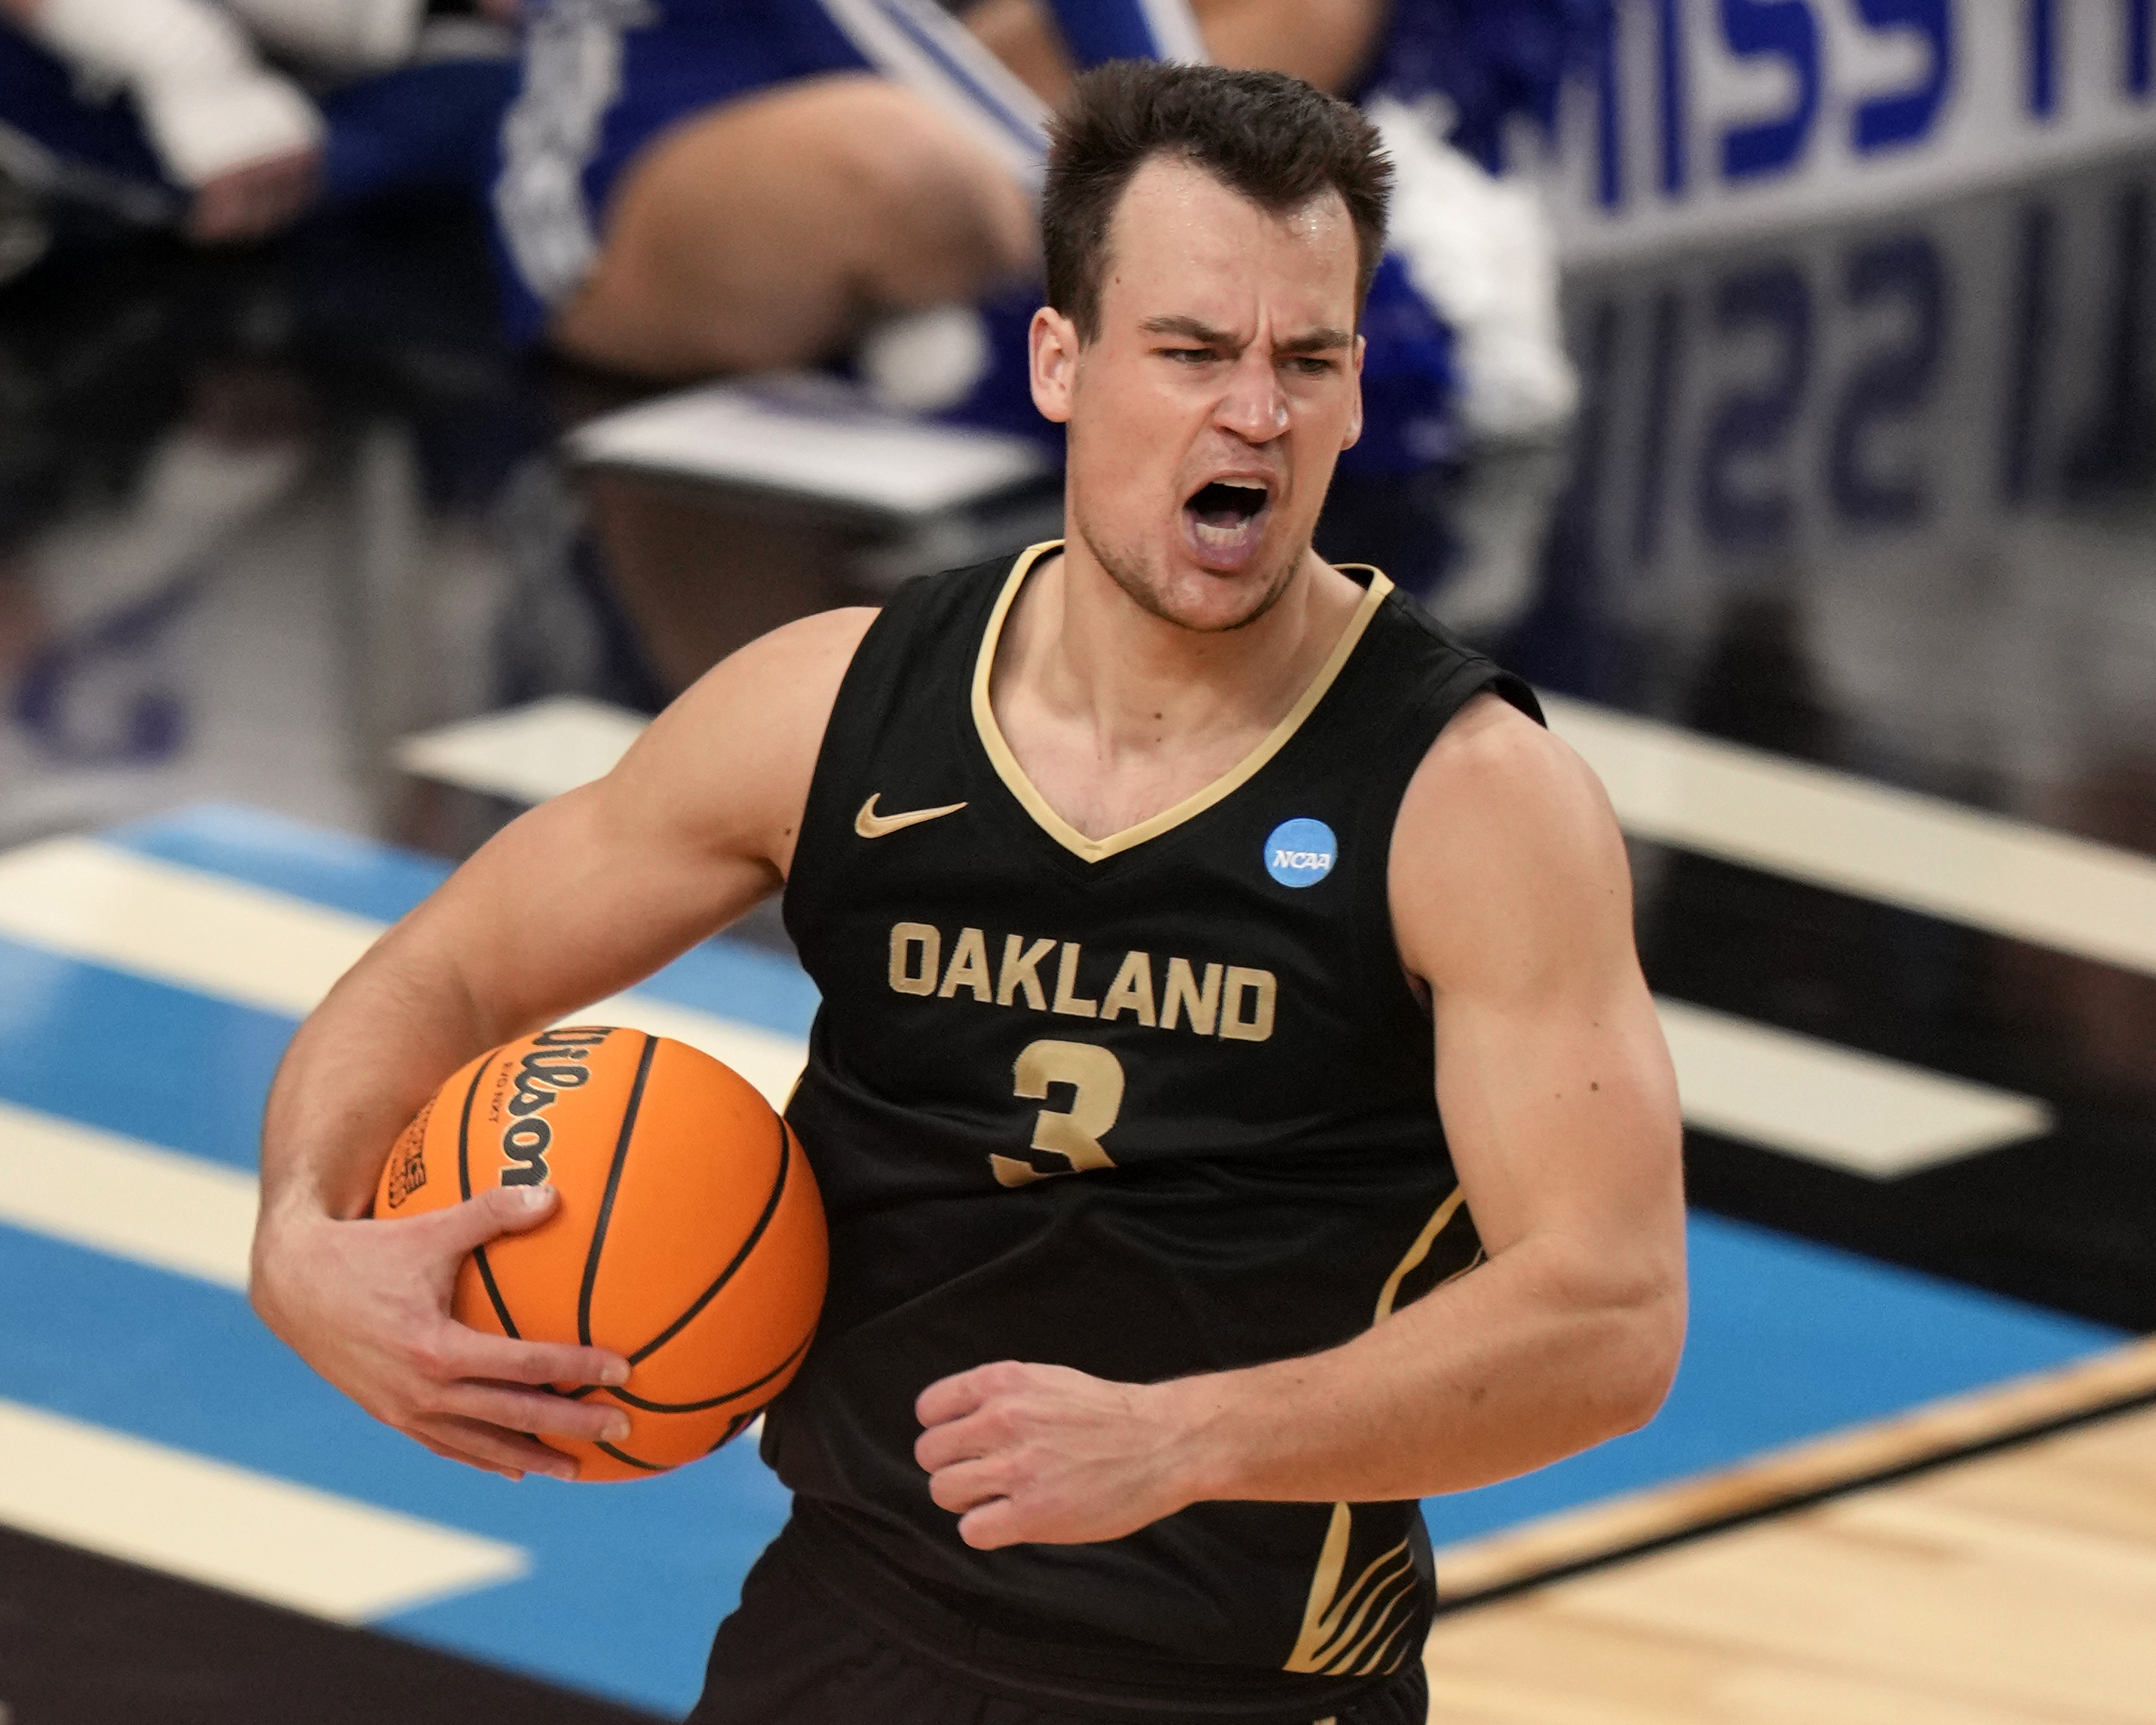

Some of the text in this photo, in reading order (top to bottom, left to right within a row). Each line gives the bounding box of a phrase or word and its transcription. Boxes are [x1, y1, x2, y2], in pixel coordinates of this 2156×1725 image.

[1273, 849, 1331, 870] NCAA
[888, 922, 1277, 1042] OAKLAND
[989, 1039, 1124, 1188] 3
